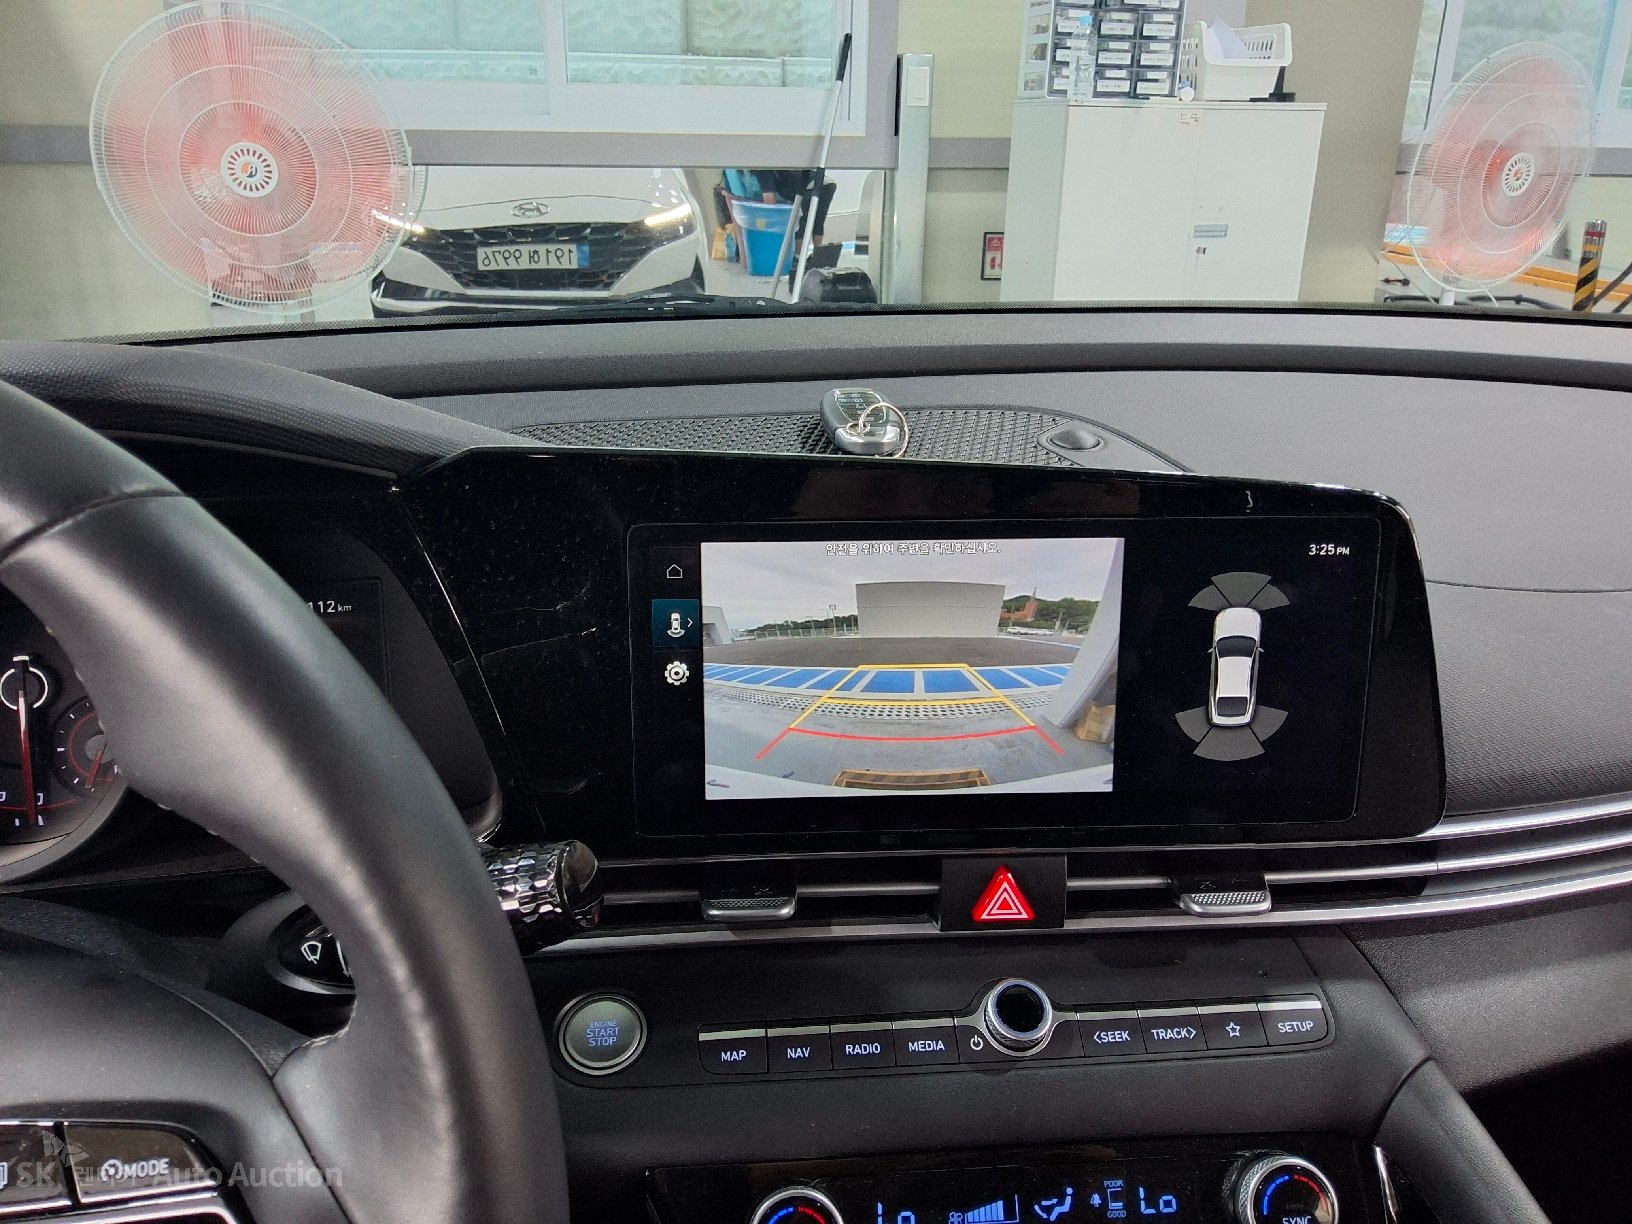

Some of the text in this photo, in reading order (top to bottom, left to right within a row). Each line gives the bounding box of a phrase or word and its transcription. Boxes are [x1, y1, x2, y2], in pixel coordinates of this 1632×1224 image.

[825, 541, 1001, 556] 안전을 위하여 주변을 확인하십시오.
[1308, 543, 1350, 556] 3:25 PM
[337, 603, 352, 612] km
[589, 1020, 618, 1029] ENGINE
[1277, 1020, 1314, 1034] SETUP
[586, 1026, 621, 1038] START
[1100, 1030, 1131, 1043] SEEK
[1150, 1027, 1189, 1041] TRACK
[588, 1036, 617, 1047] STOP
[908, 1039, 946, 1053] MEDIA
[786, 1046, 811, 1060] NAV
[845, 1042, 881, 1056] RADIO
[720, 1049, 748, 1063] MAP
[123, 1158, 170, 1179] MODE
[1103, 1179, 1124, 1188] POOR
[1107, 1210, 1127, 1219] GOOD
